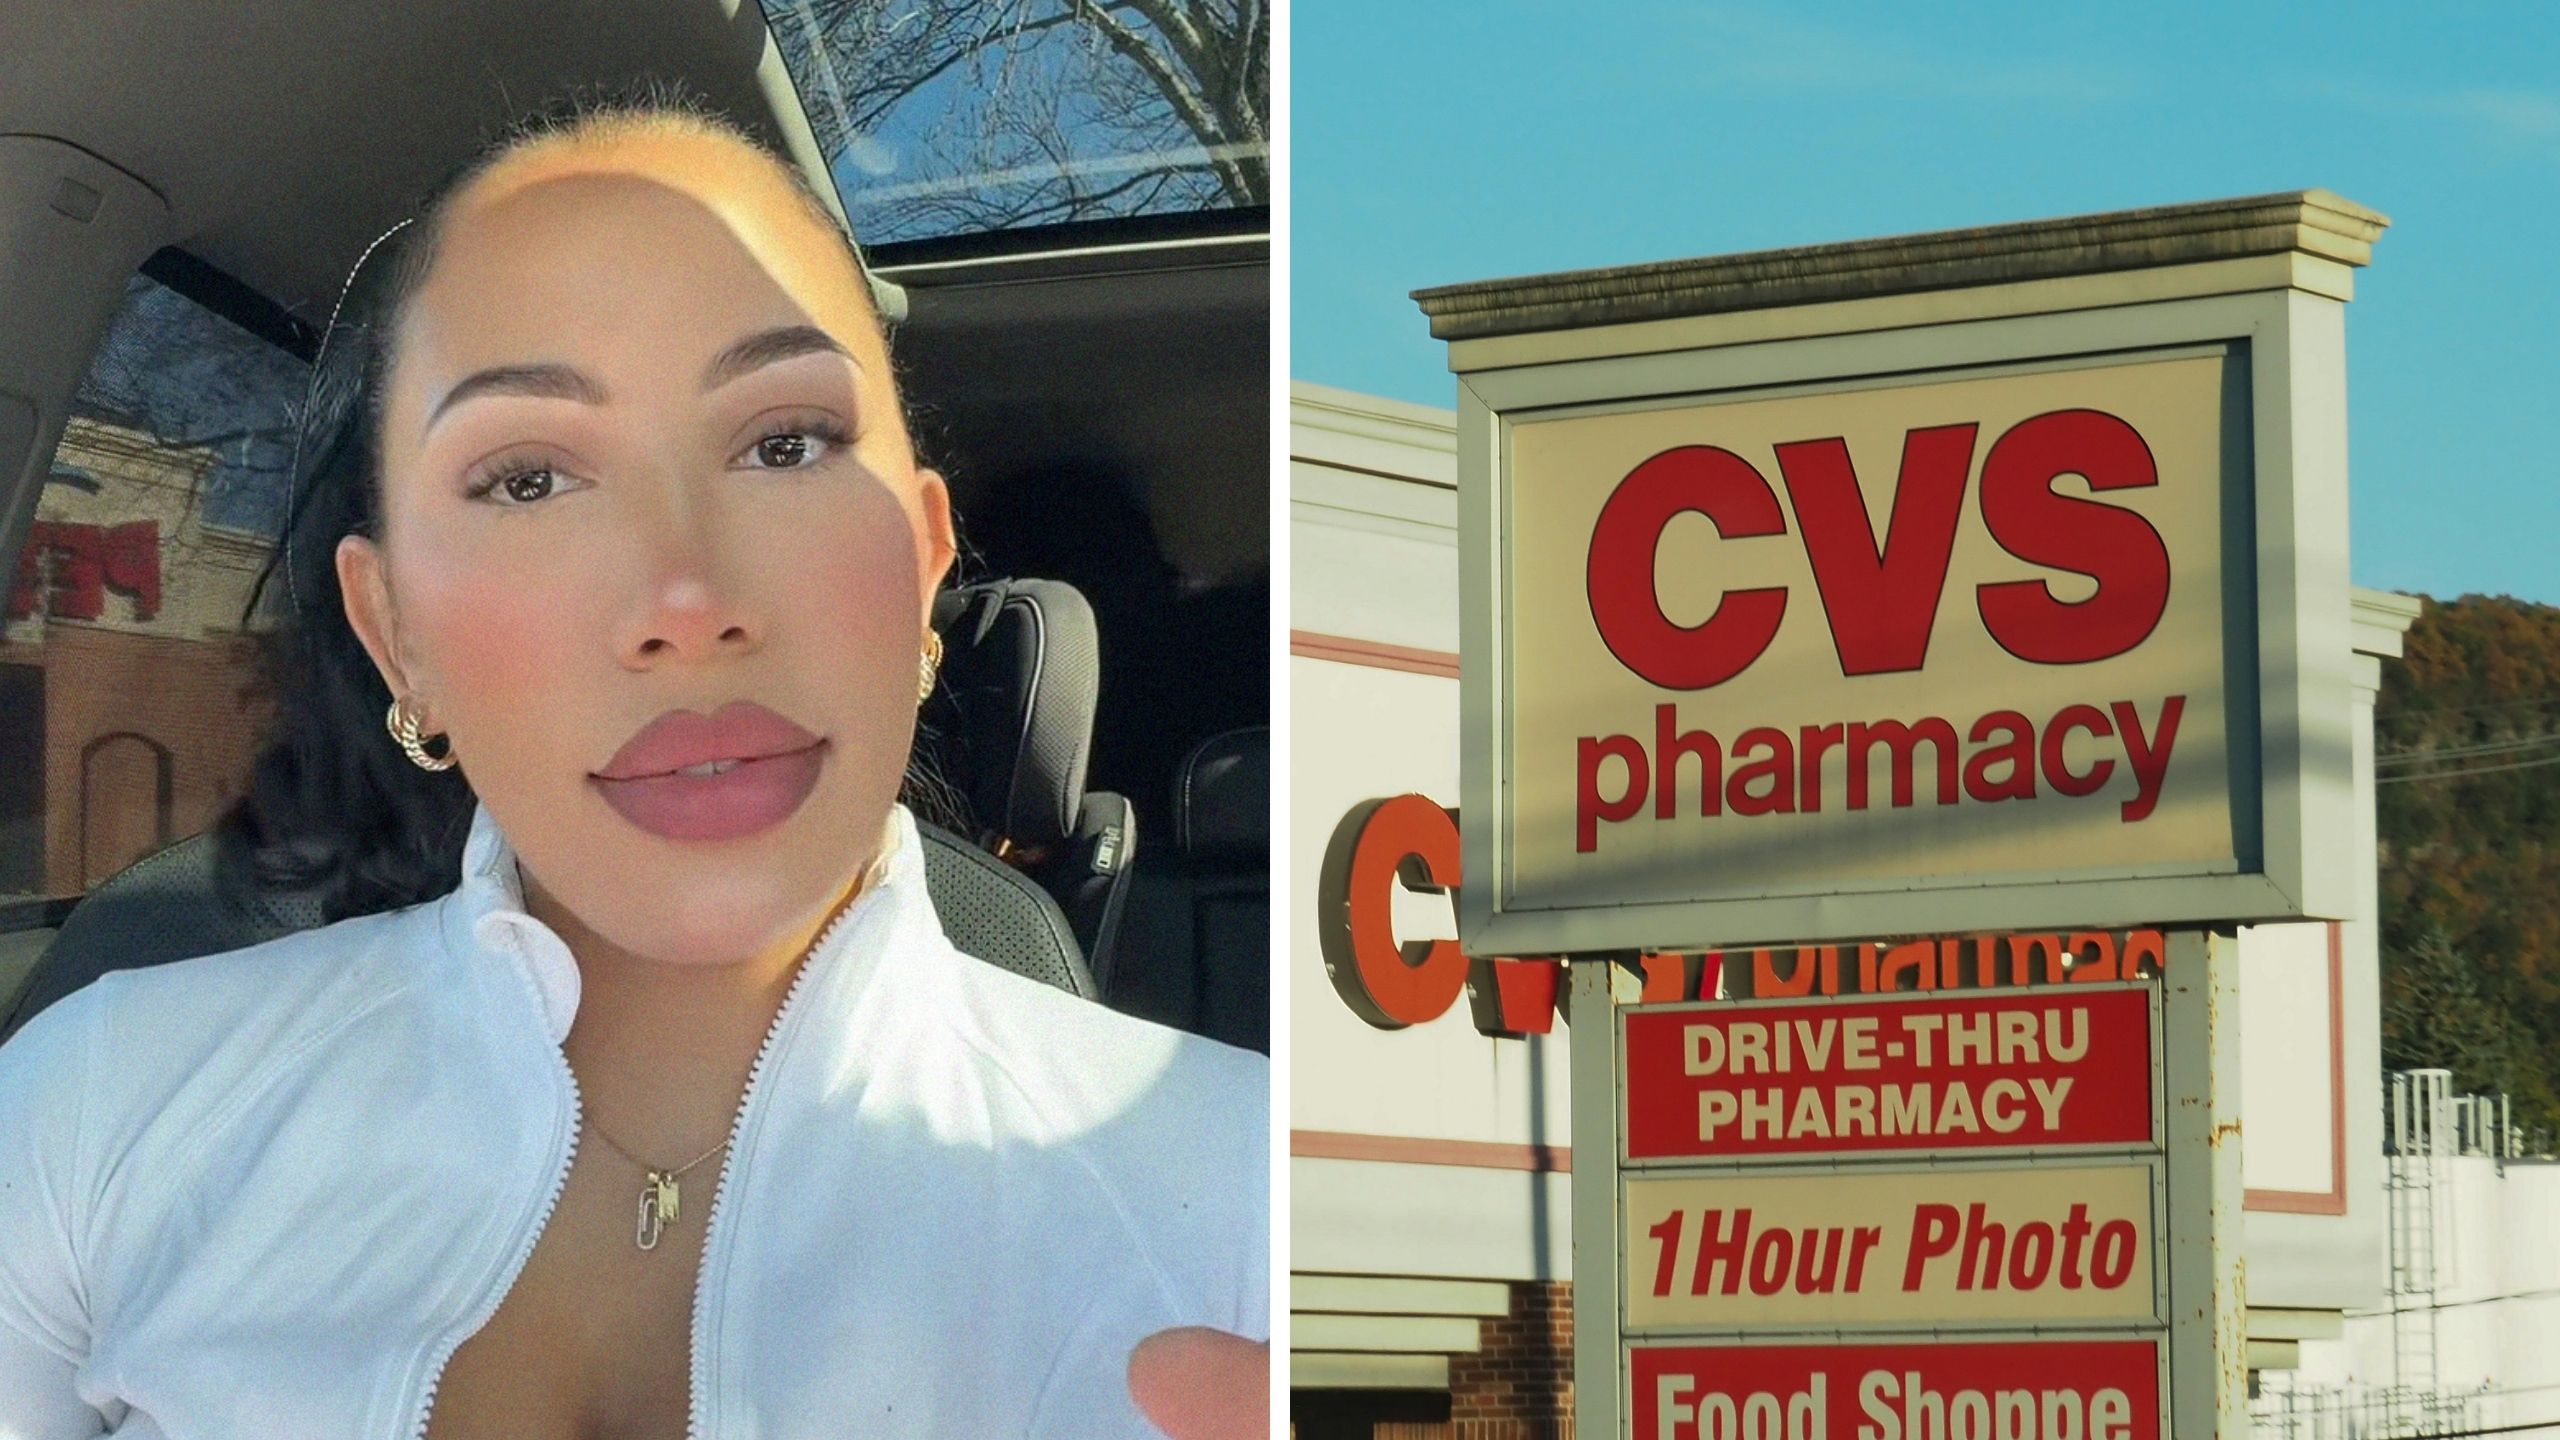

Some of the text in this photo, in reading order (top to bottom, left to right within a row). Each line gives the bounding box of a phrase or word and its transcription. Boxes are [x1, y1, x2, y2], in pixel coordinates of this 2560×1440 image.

[1587, 409, 2170, 691] CVS
[1576, 696, 2186, 853] pharmacy
[1683, 1007, 2090, 1077] DRIVE-THRU
[1698, 1077, 2075, 1141] PHARMACY
[1902, 1202, 2138, 1293] Photo
[1656, 1371, 1828, 1440] Food
